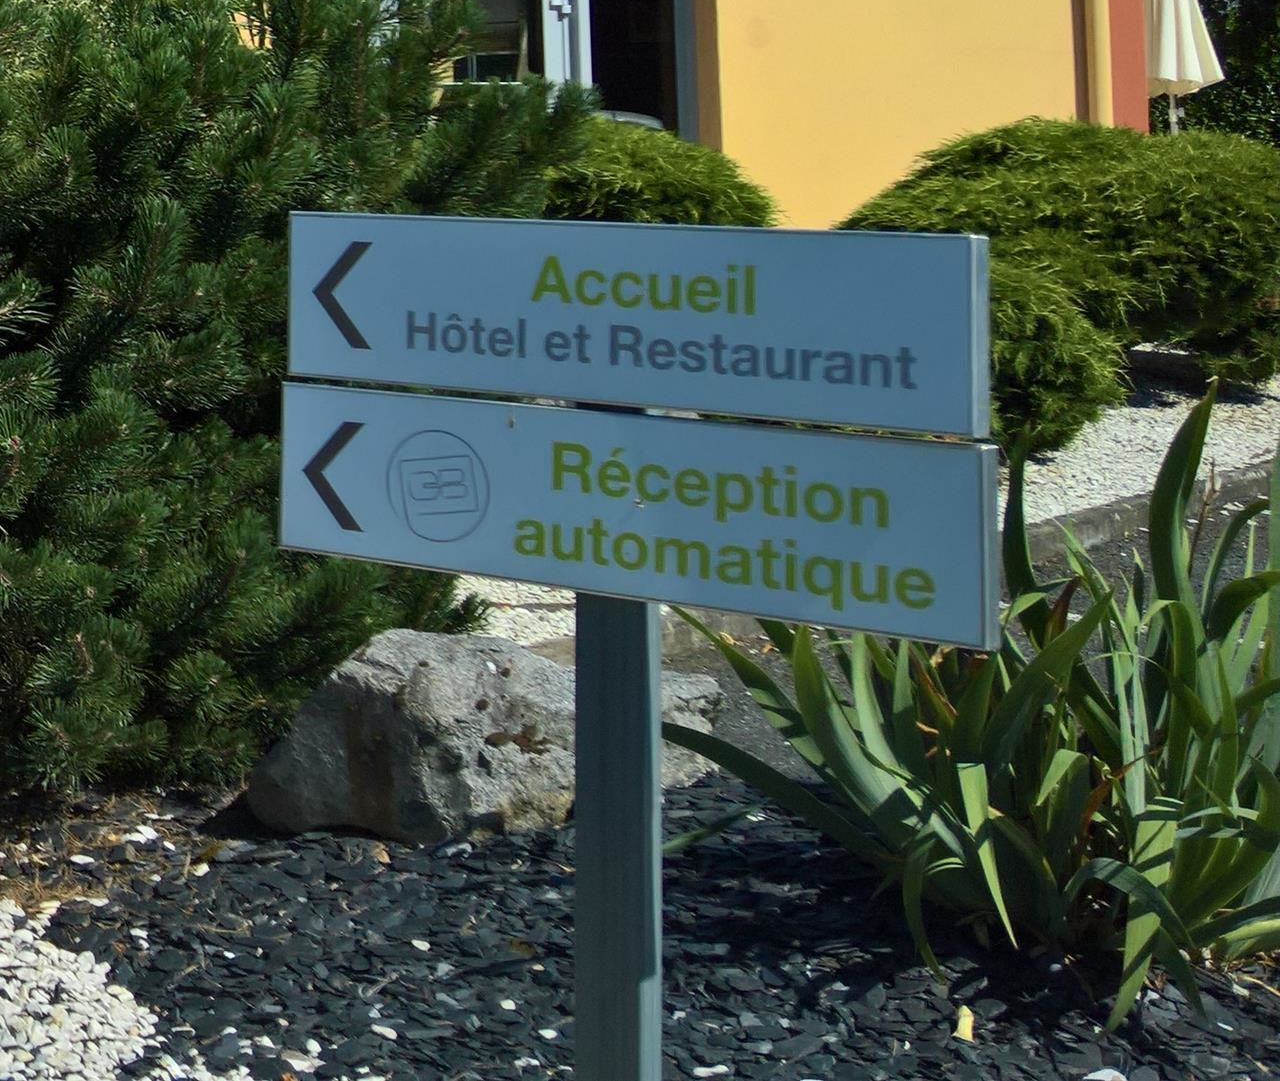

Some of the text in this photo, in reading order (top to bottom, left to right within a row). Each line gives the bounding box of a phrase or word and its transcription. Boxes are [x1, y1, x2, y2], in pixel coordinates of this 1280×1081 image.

[531, 255, 756, 315] Accueil
[406, 311, 917, 389] Hôtel et Restaurant
[552, 442, 889, 528] Réception
[514, 520, 935, 610] automatique
